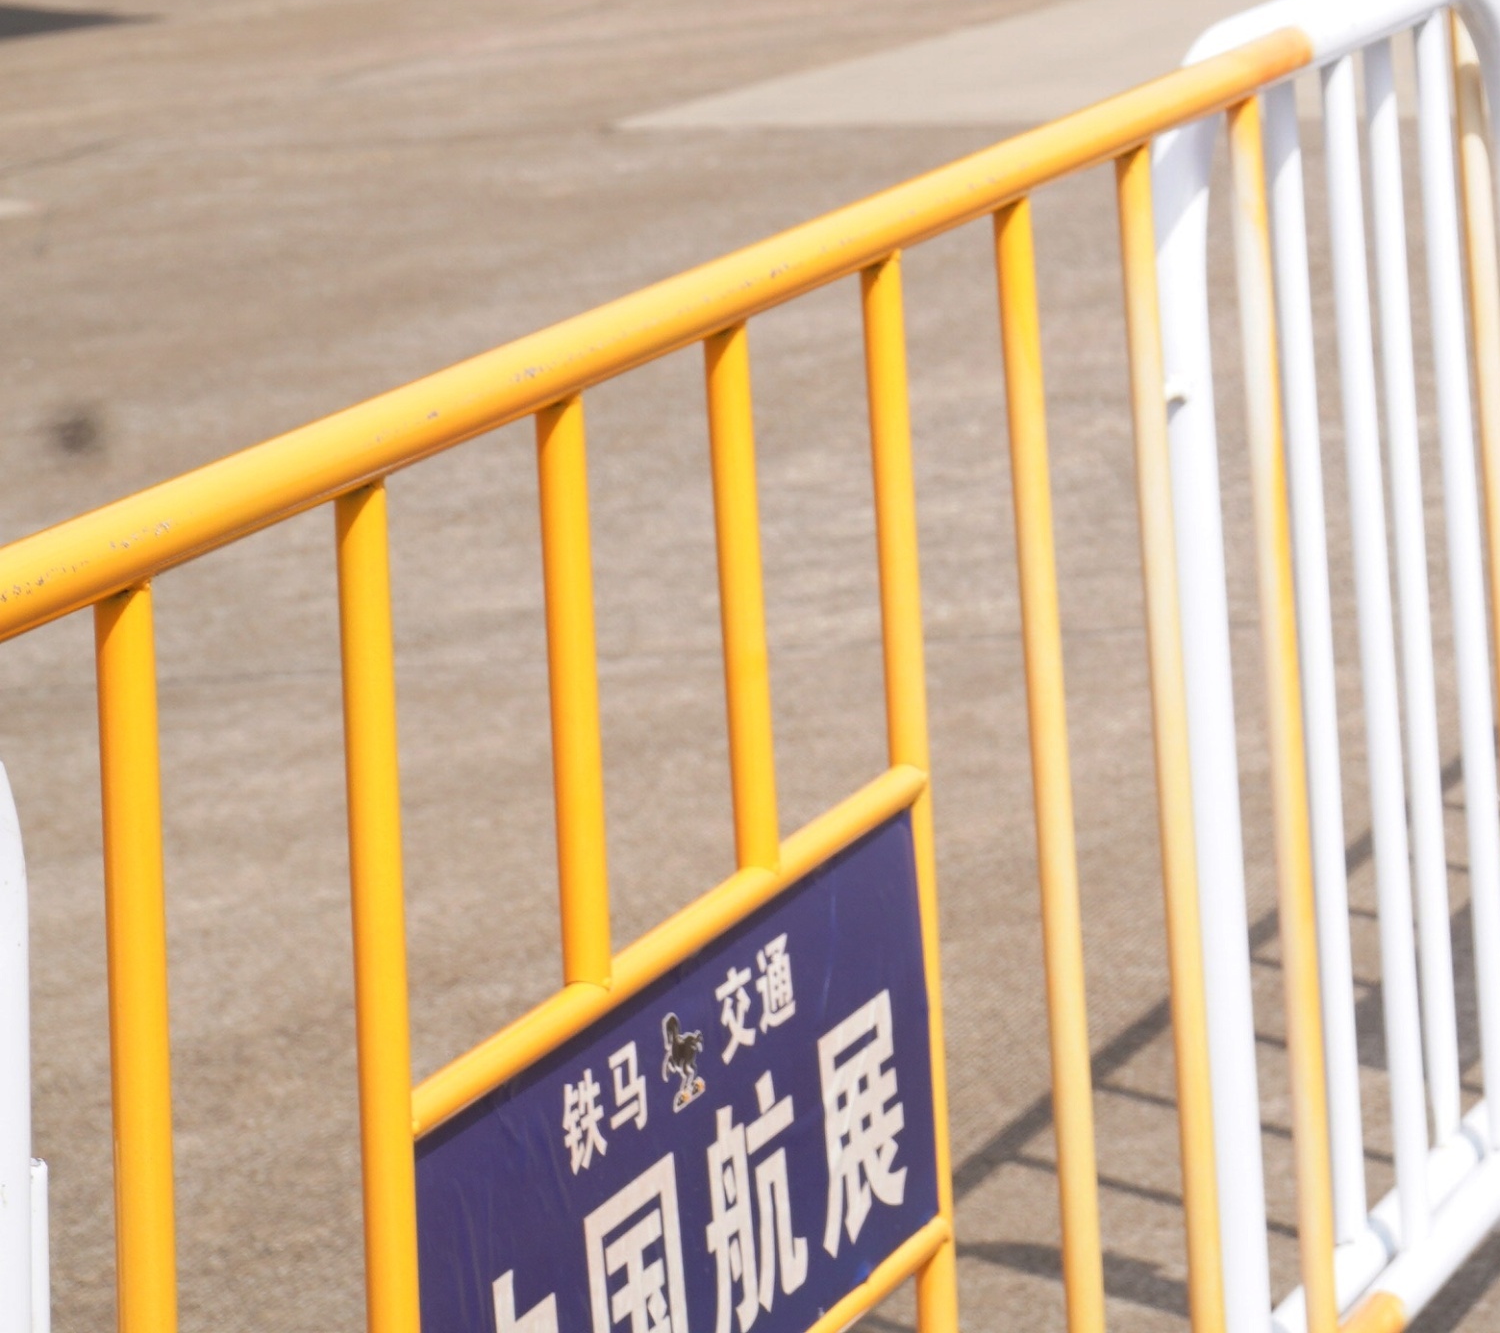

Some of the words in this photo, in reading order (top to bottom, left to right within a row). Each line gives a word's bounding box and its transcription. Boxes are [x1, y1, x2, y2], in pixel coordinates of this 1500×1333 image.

[490, 988, 908, 1333] 国航展
[562, 1041, 648, 1176] 铁马
[715, 933, 796, 1064] 交通
